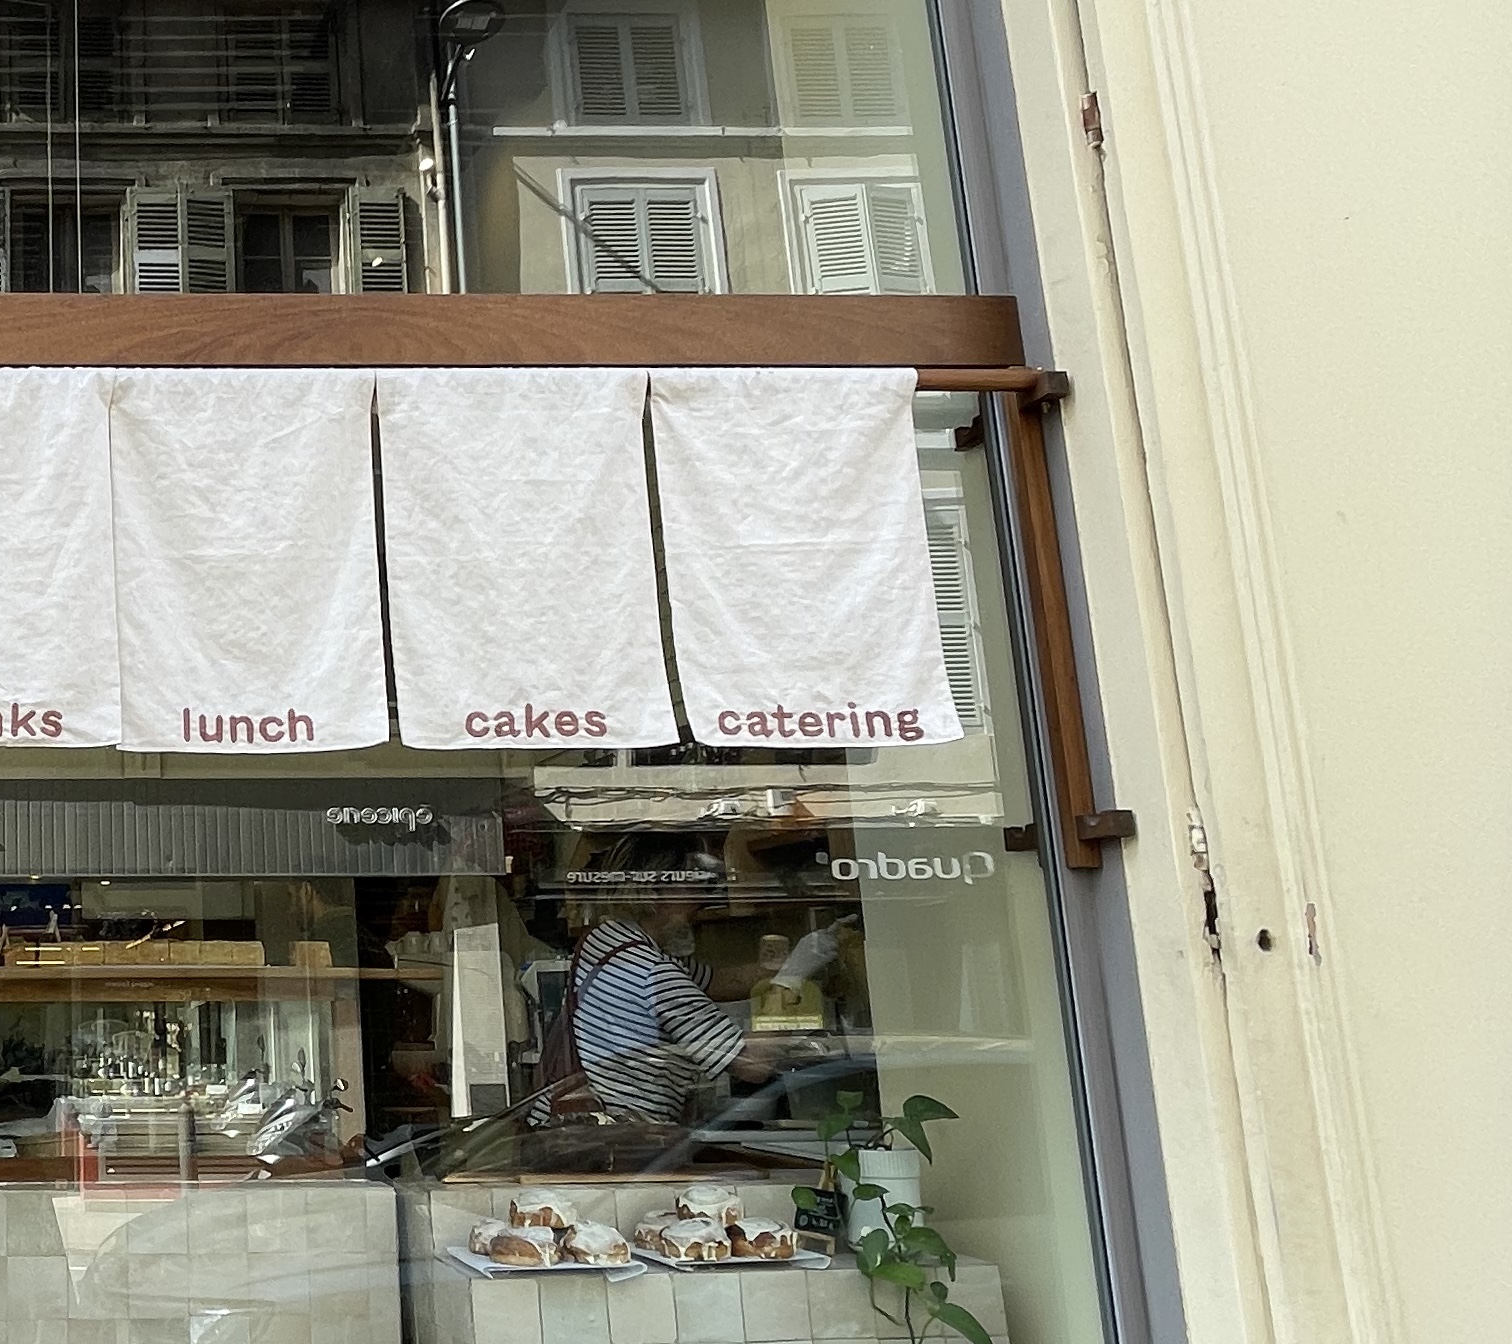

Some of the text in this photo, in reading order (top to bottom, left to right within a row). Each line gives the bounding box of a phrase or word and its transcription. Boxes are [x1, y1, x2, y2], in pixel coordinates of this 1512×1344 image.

[182, 707, 316, 744] lunch
[464, 703, 609, 739] cakes
[716, 702, 926, 741] catering
